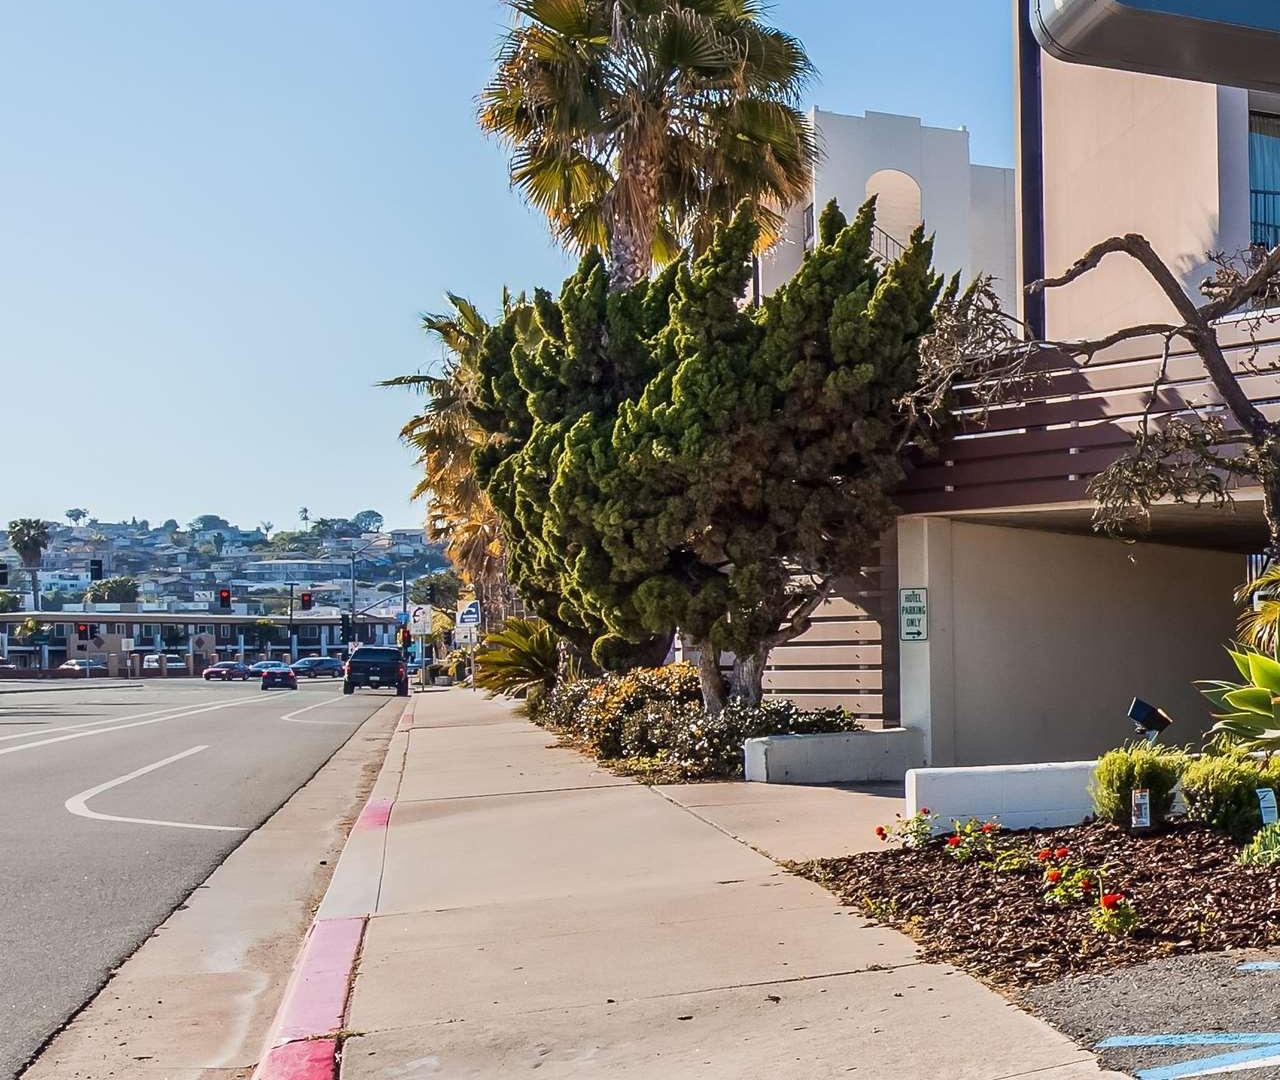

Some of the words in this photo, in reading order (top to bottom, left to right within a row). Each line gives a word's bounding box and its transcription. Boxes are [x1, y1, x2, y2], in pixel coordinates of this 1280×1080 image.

[904, 593, 922, 603] HOTEL
[902, 605, 925, 615] PARKING
[906, 618, 921, 627] ONLY
